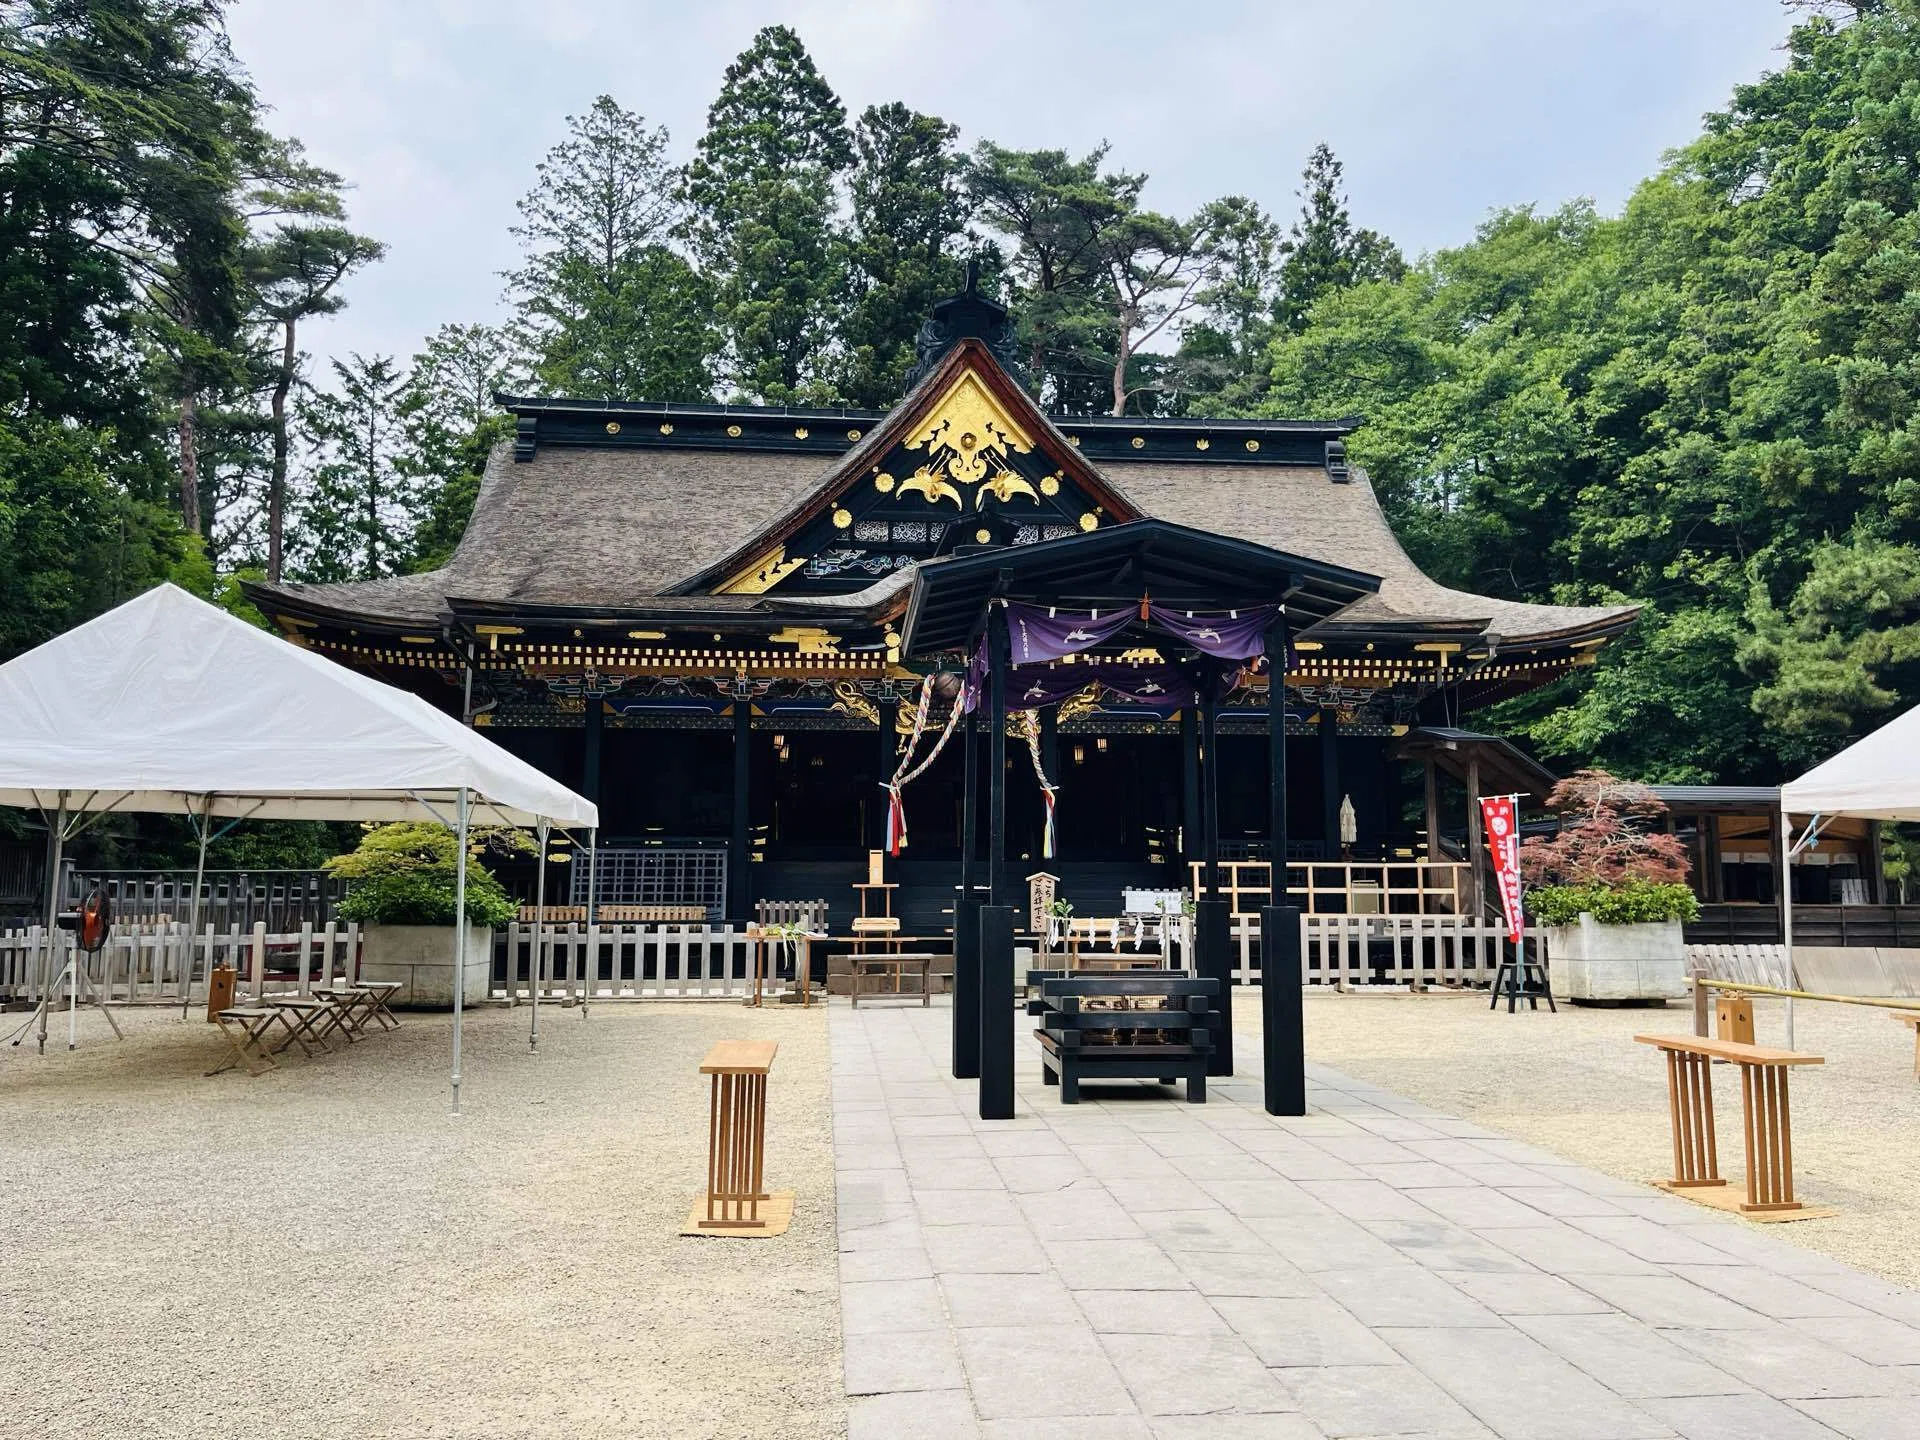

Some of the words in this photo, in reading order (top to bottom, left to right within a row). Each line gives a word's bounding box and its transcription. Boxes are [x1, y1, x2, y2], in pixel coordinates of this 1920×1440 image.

[1034, 878, 1043, 929] ご参拝下さい
